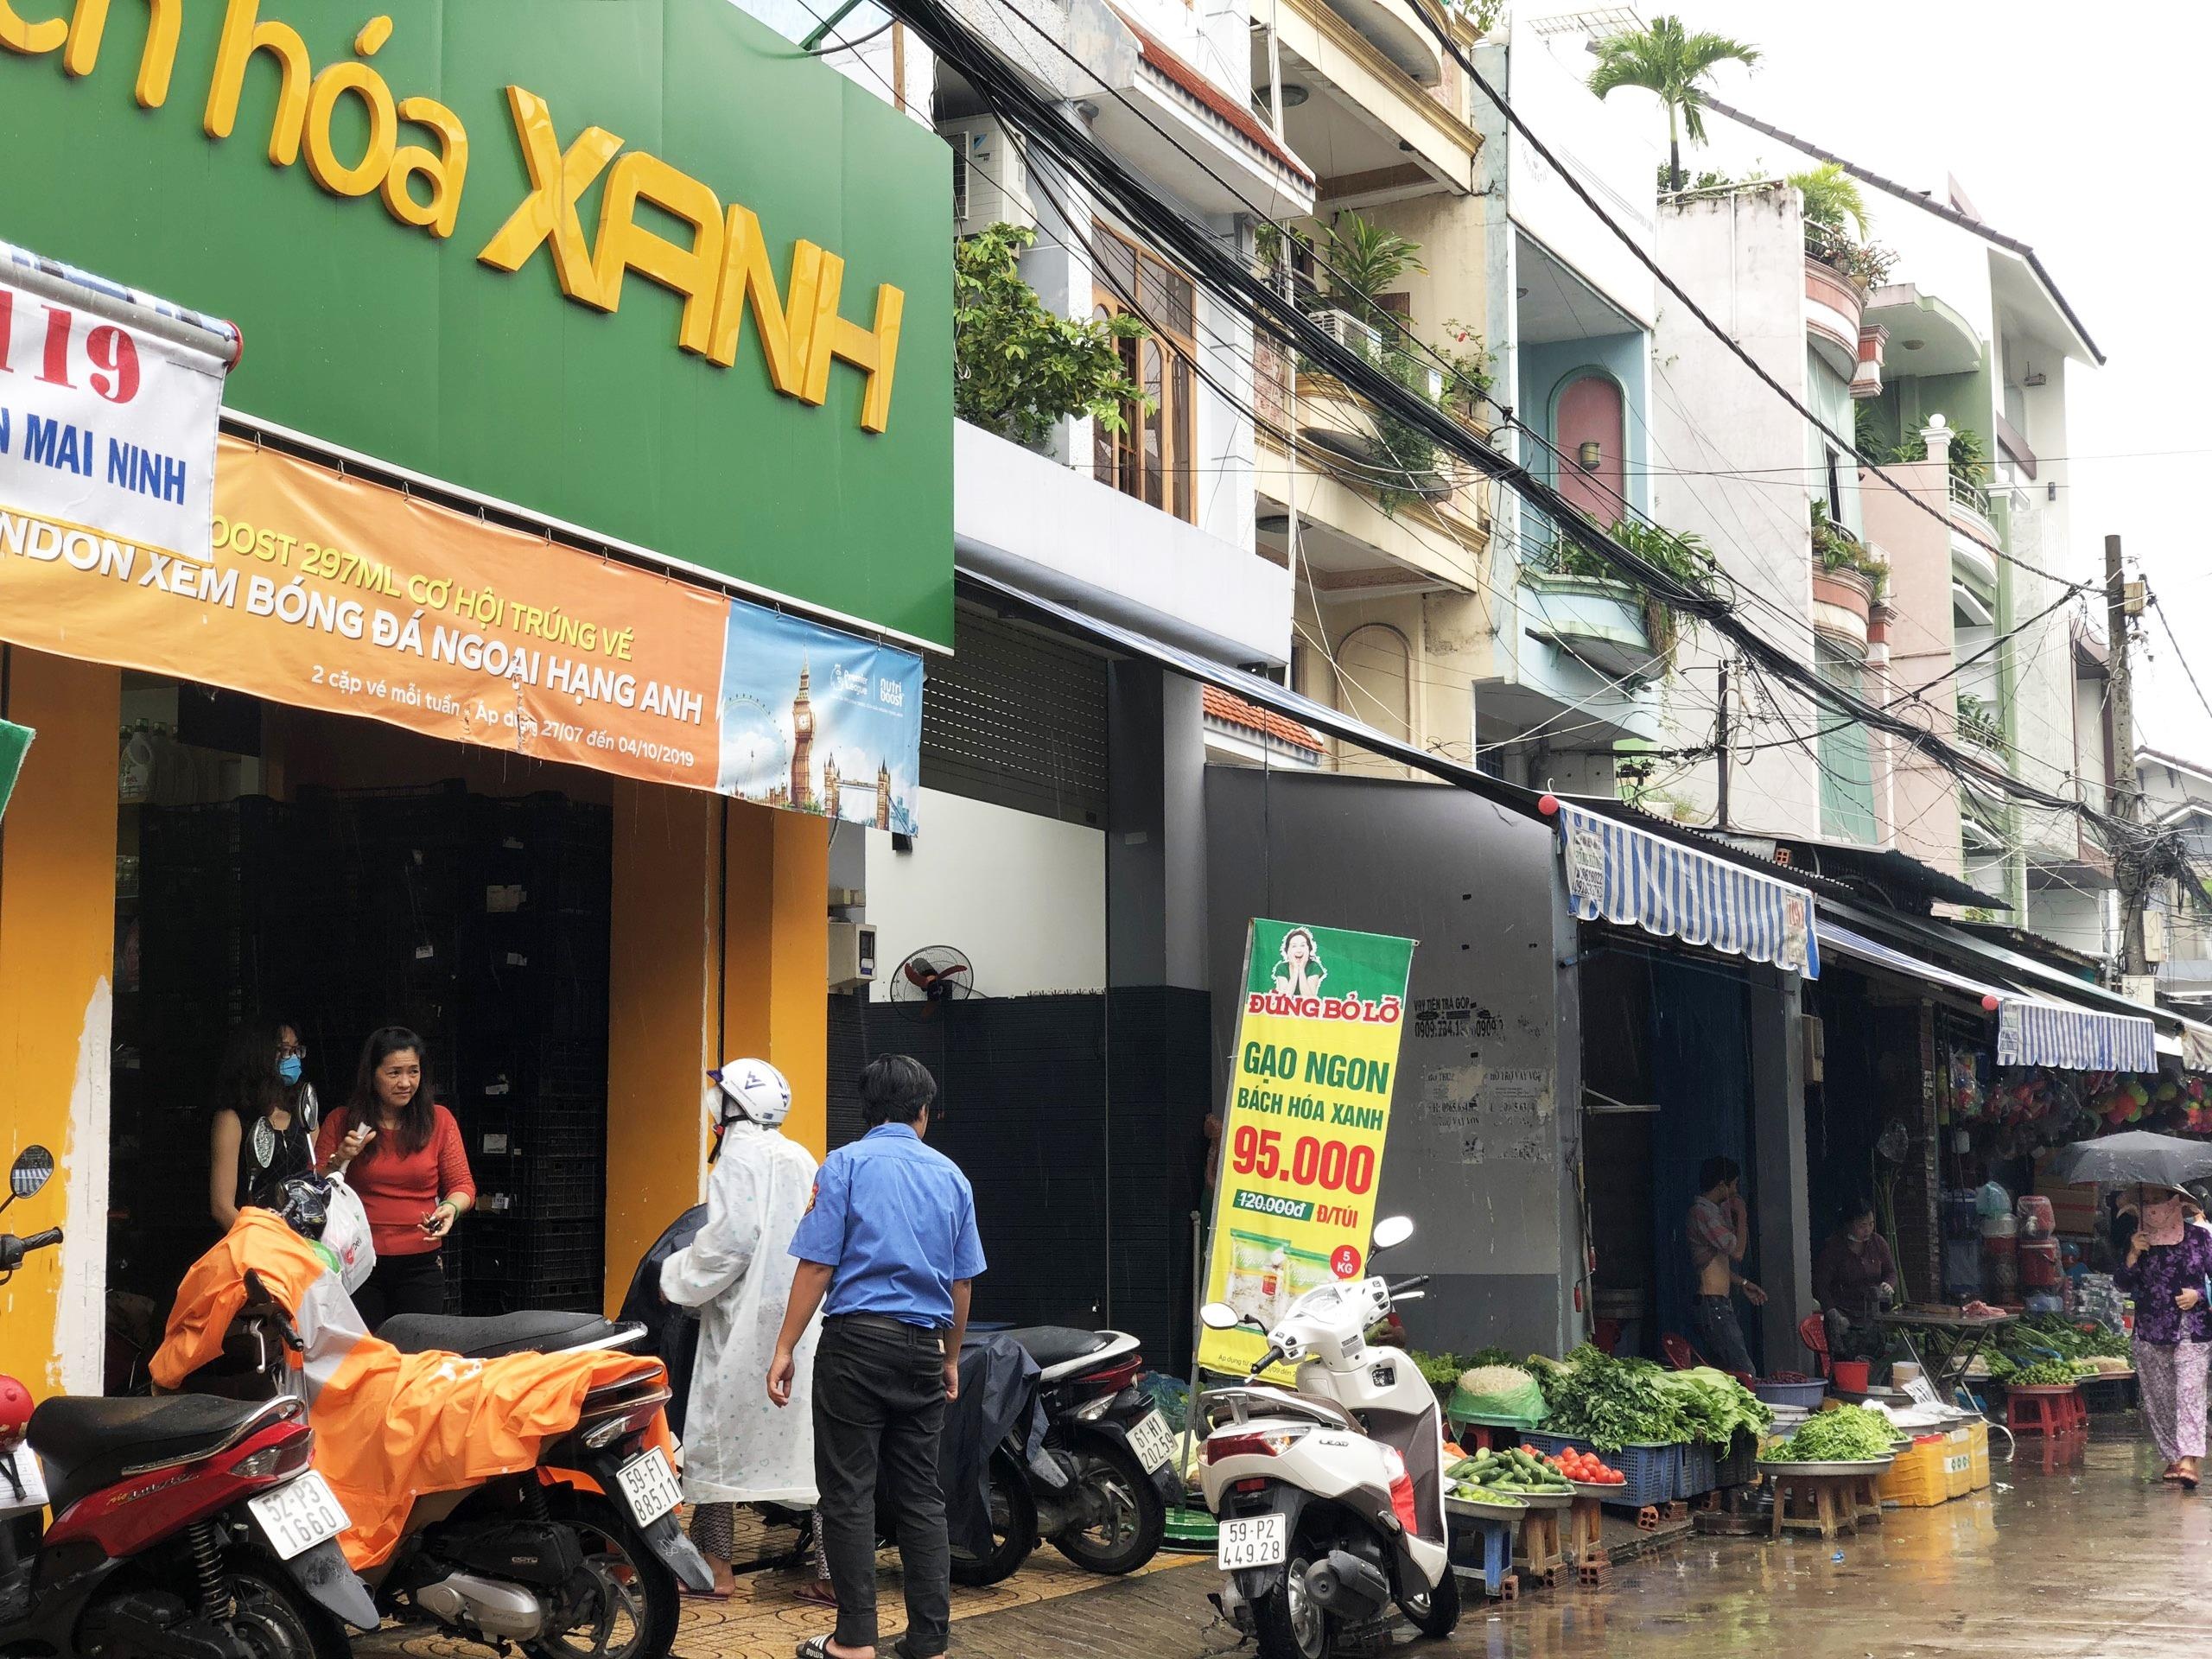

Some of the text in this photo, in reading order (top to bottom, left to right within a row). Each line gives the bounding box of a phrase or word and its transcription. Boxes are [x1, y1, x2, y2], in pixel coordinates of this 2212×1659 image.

[476, 86, 904, 433] XANH
[24, 413, 92, 477] MAI
[107, 437, 187, 505] NINH
[300, 543, 402, 598] 297ML
[408, 574, 453, 610] CƠ
[454, 586, 505, 631] HỘI
[510, 601, 597, 651] TRÚNG
[602, 626, 634, 661] VÉ
[138, 551, 239, 608] XEM
[246, 575, 364, 639] BÓNG
[372, 608, 424, 657] ĐÁ
[431, 625, 541, 690] NGOẠI
[546, 656, 637, 708] HẠNG
[639, 681, 703, 726] ANH
[880, 677, 902, 694] nutri
[880, 687, 904, 708] boost
[311, 664, 324, 684] 2
[328, 671, 361, 694] cặp
[365, 679, 387, 698] vé
[391, 682, 421, 706] mỗi
[425, 692, 461, 716] tuần
[475, 700, 499, 727] Áp
[540, 721, 583, 743] 27/07
[587, 729, 614, 751] đến
[619, 736, 695, 767] 04/10/2019
[1249, 989, 1400, 1023] ĐỪNG BỎ LỠ
[1243, 1041, 1389, 1095] GẠO NGON
[1236, 1085, 1383, 1131] BÁCH HÓA XANH
[1232, 1125, 1376, 1195] 95.000
[1238, 1192, 1358, 1229] 120.000đ Đ/TÚI
[1337, 1262, 1353, 1274] KG
[1343, 1251, 1351, 1262] 5
[1133, 1419, 1163, 1449] 61-H1
[1141, 1432, 1177, 1471] 202.59
[626, 1456, 664, 1494] 59-F1
[262, 1480, 321, 1522] 52-P3
[634, 1478, 679, 1521] 885.11
[280, 1506, 337, 1548] 1660
[1229, 1519, 1274, 1542] 59-P2
[1223, 1541, 1281, 1567] 449.28
